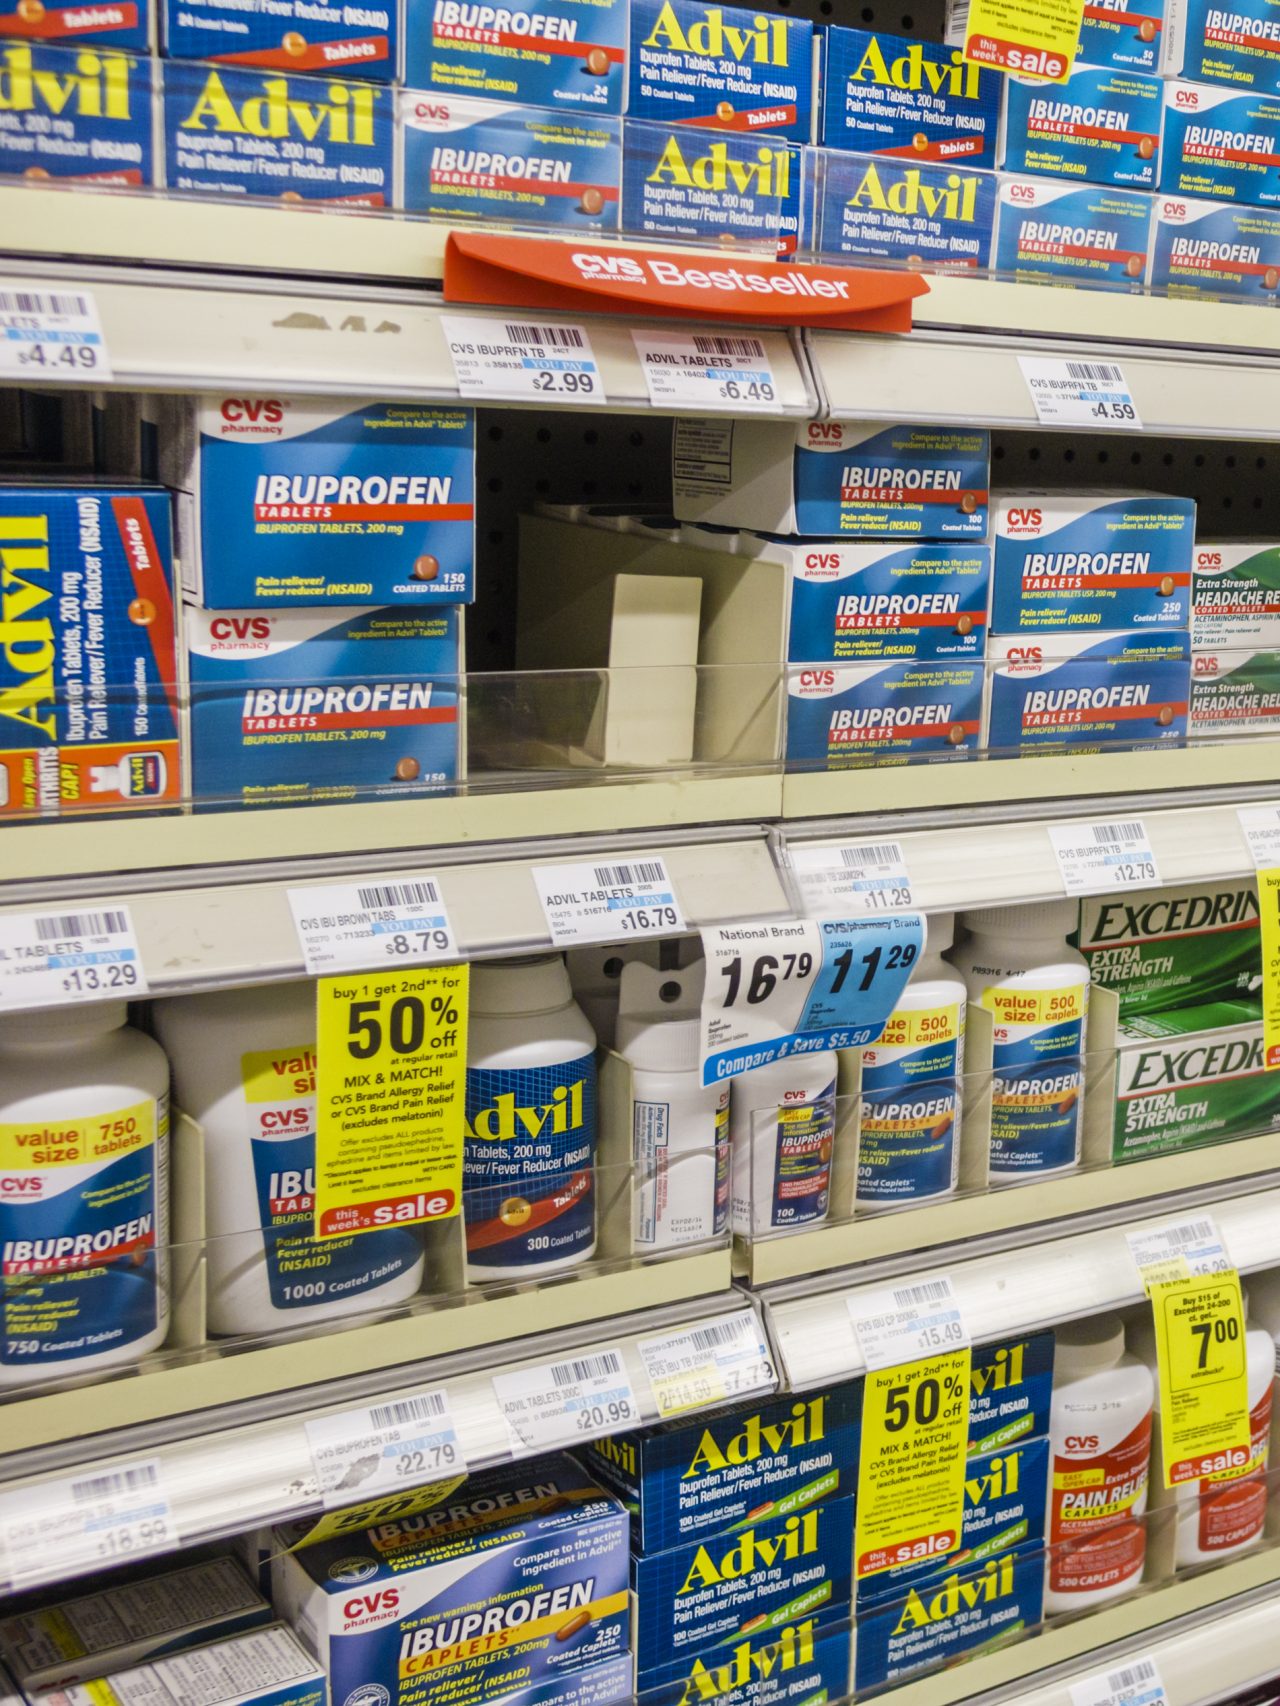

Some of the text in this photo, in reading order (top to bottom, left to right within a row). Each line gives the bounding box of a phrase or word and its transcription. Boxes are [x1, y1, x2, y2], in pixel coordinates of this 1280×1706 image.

[642, 2, 791, 68] Advil
[639, 47, 751, 79] Ibuprofen Tablets, 200 mg
[850, 36, 981, 99] Advil
[1006, 47, 1062, 78] sale
[639, 67, 796, 101] Pain Reliever/Fever Reducer (NSAID)
[181, 70, 375, 147] Advil
[1029, 99, 1129, 130] IBUPROFEN
[1184, 126, 1274, 154] IBUPROFEN
[431, 147, 571, 183] IBUPROFEN
[572, 252, 642, 276] CVS
[582, 271, 646, 285] pharmacy
[659, 260, 850, 299] Bestseller
[477, 343, 529, 357] IBUPRFN
[680, 353, 732, 369] TABLETS
[221, 400, 284, 422] CVS
[221, 422, 284, 437] pharmacy
[255, 475, 450, 504] IBUPROFEN
[842, 467, 961, 490] IBUPROFEN
[1007, 508, 1042, 527] CVS
[127, 517, 150, 571] Tablets
[1023, 552, 1150, 577] IBUPROFEN
[837, 595, 959, 616] IBUPROFEN
[1195, 591, 1263, 605] HEADACHE
[242, 683, 432, 713] IBUPROFEN
[61, 762, 80, 799] CAP!
[582, 888, 633, 902] TABLETS
[720, 924, 805, 940] National Brand
[893, 917, 921, 931] Brand
[15, 941, 83, 959] TABLETS
[1090, 947, 1141, 968] EXTRA
[1089, 956, 1172, 983] STRENGTH
[994, 996, 1037, 1010] value
[1049, 995, 1075, 1010] 500
[1003, 1009, 1037, 1023] size
[1045, 1007, 1078, 1023] caplets
[430, 1029, 456, 1050] off
[717, 1048, 774, 1078] Compare
[790, 1033, 824, 1053] Save
[345, 1075, 369, 1089] MIX
[390, 1066, 442, 1084] MATCH!
[100, 1118, 136, 1138] 750
[261, 1108, 309, 1127] CVS
[391, 1108, 443, 1125] melatonin)
[16, 1129, 78, 1147] value
[94, 1133, 141, 1156] tablets
[32, 1146, 79, 1164] size
[373, 1194, 448, 1223] sale
[2, 1214, 152, 1262] IBUPROFEN
[551, 1231, 575, 1247] Coated
[283, 1259, 402, 1299] 1000 Coated Tablets
[681, 1400, 826, 1480] Advil
[1065, 1436, 1099, 1450] CVS
[1201, 1450, 1246, 1474] sale
[1061, 1492, 1097, 1511] PAIN
[513, 1550, 561, 1568] Compare
[594, 1528, 622, 1545] active
[676, 1512, 819, 1596] Advil
[897, 1534, 951, 1561] sale
[344, 1589, 400, 1619] CVS
[443, 1600, 487, 1621] warnings
[489, 1582, 544, 1608] information
[891, 1558, 1015, 1637] Advil
[344, 1609, 400, 1630] pharmacy
[400, 1578, 594, 1659] IBUPROFEN
[404, 1630, 509, 1674] CAPLETS
